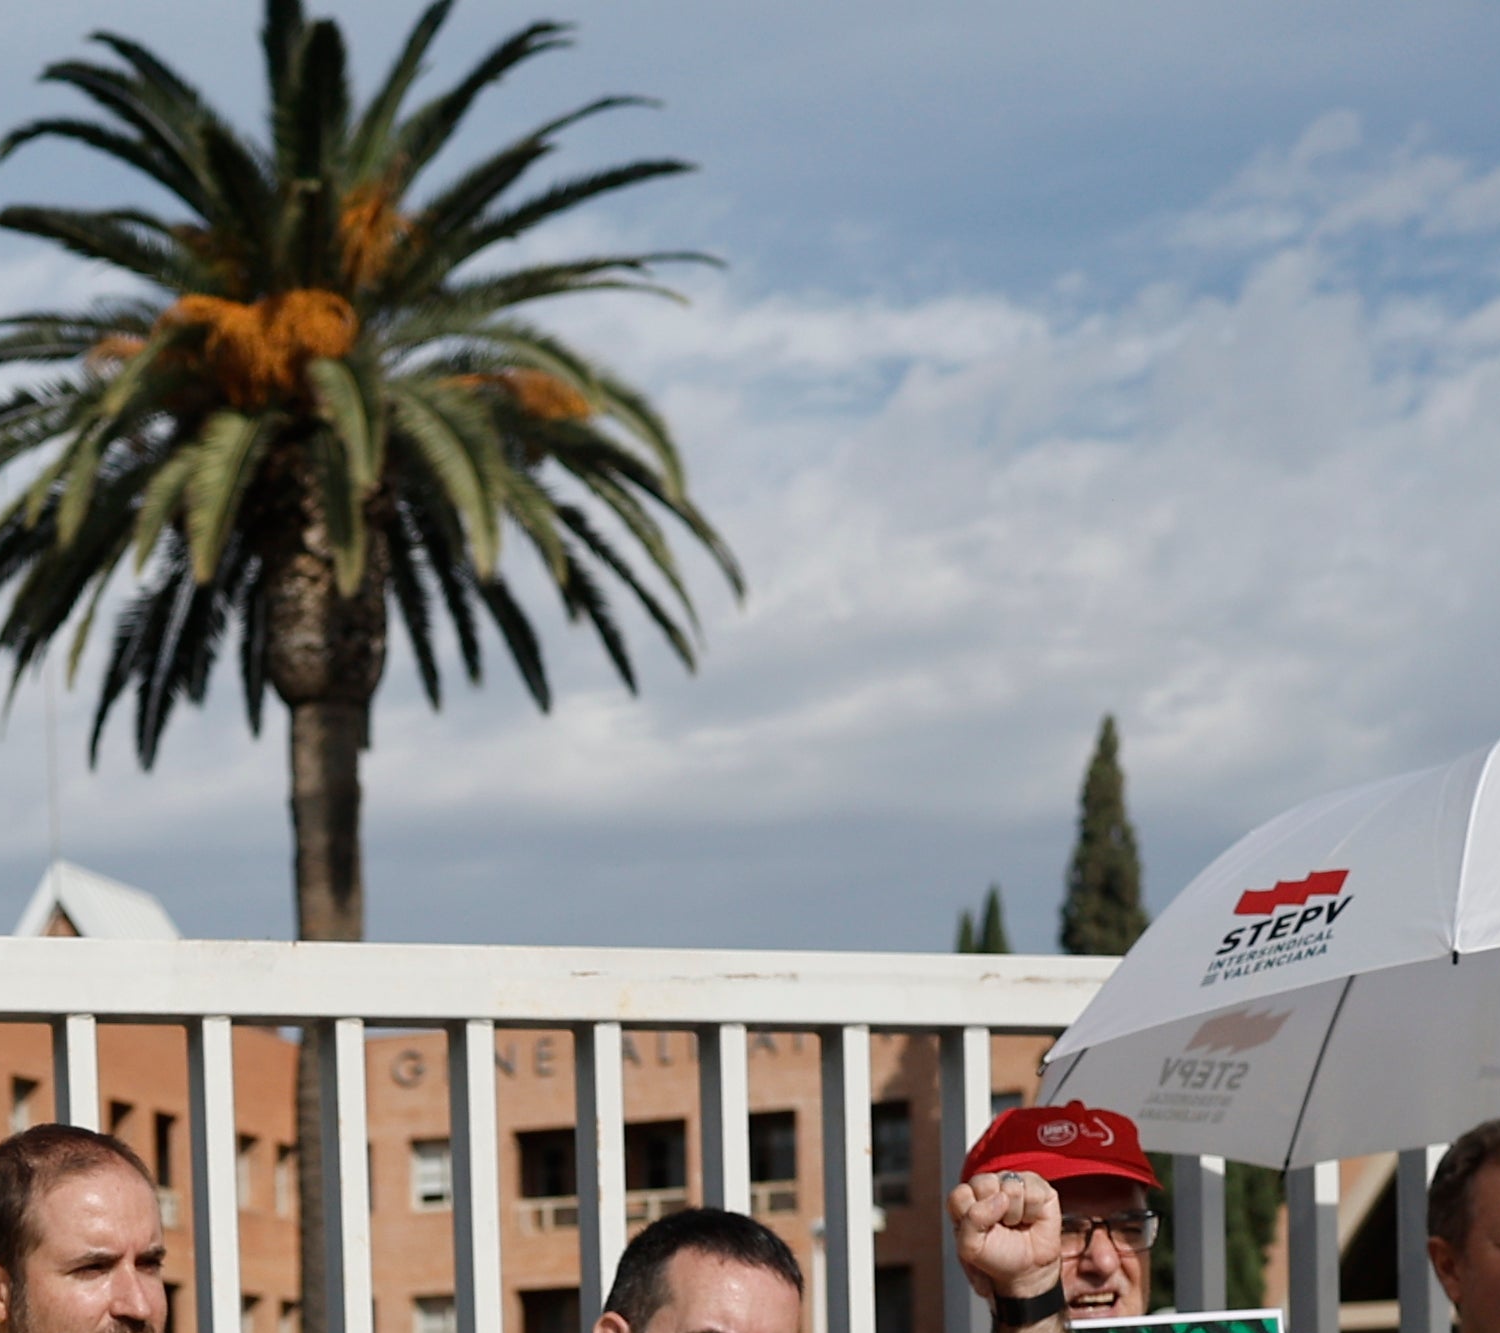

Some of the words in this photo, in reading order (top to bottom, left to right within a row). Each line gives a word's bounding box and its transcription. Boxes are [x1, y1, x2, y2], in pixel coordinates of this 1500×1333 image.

[1216, 895, 1354, 955] STEPV
[1207, 928, 1335, 971] INTERSINDICAL
[1221, 943, 1329, 983] VALENCIANA
